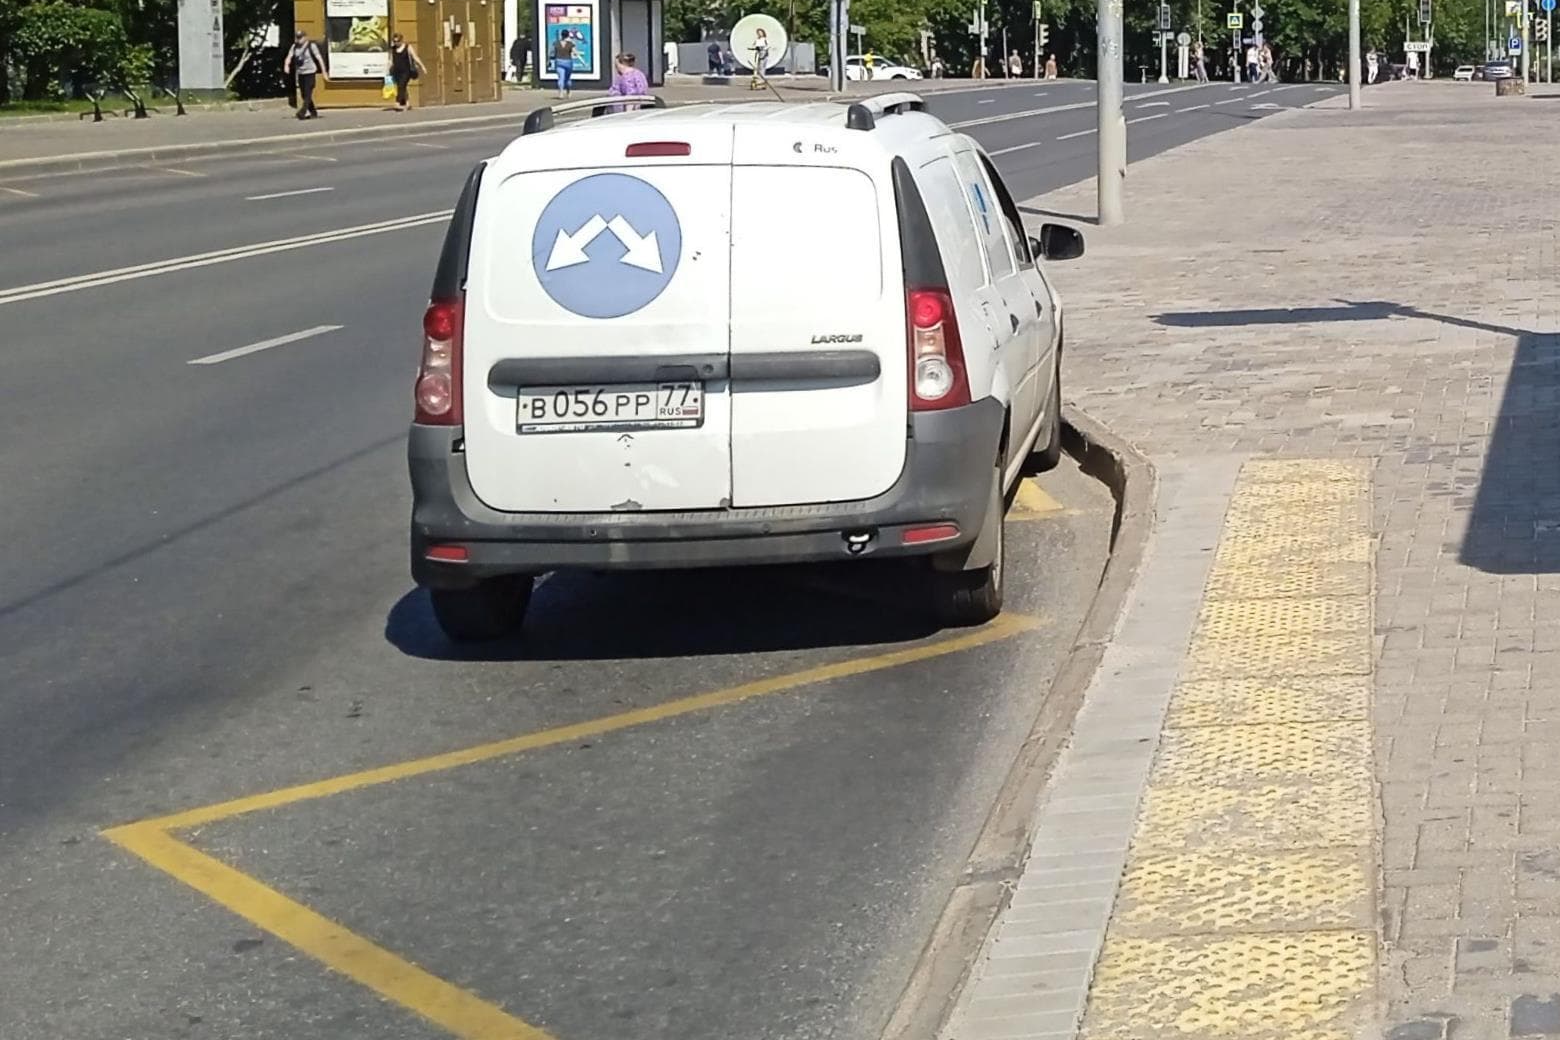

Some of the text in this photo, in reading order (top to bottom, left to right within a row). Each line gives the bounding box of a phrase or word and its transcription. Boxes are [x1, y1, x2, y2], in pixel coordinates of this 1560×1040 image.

[811, 334, 864, 345] LARGUS
[661, 384, 692, 407] 77
[659, 407, 682, 416] RUS
